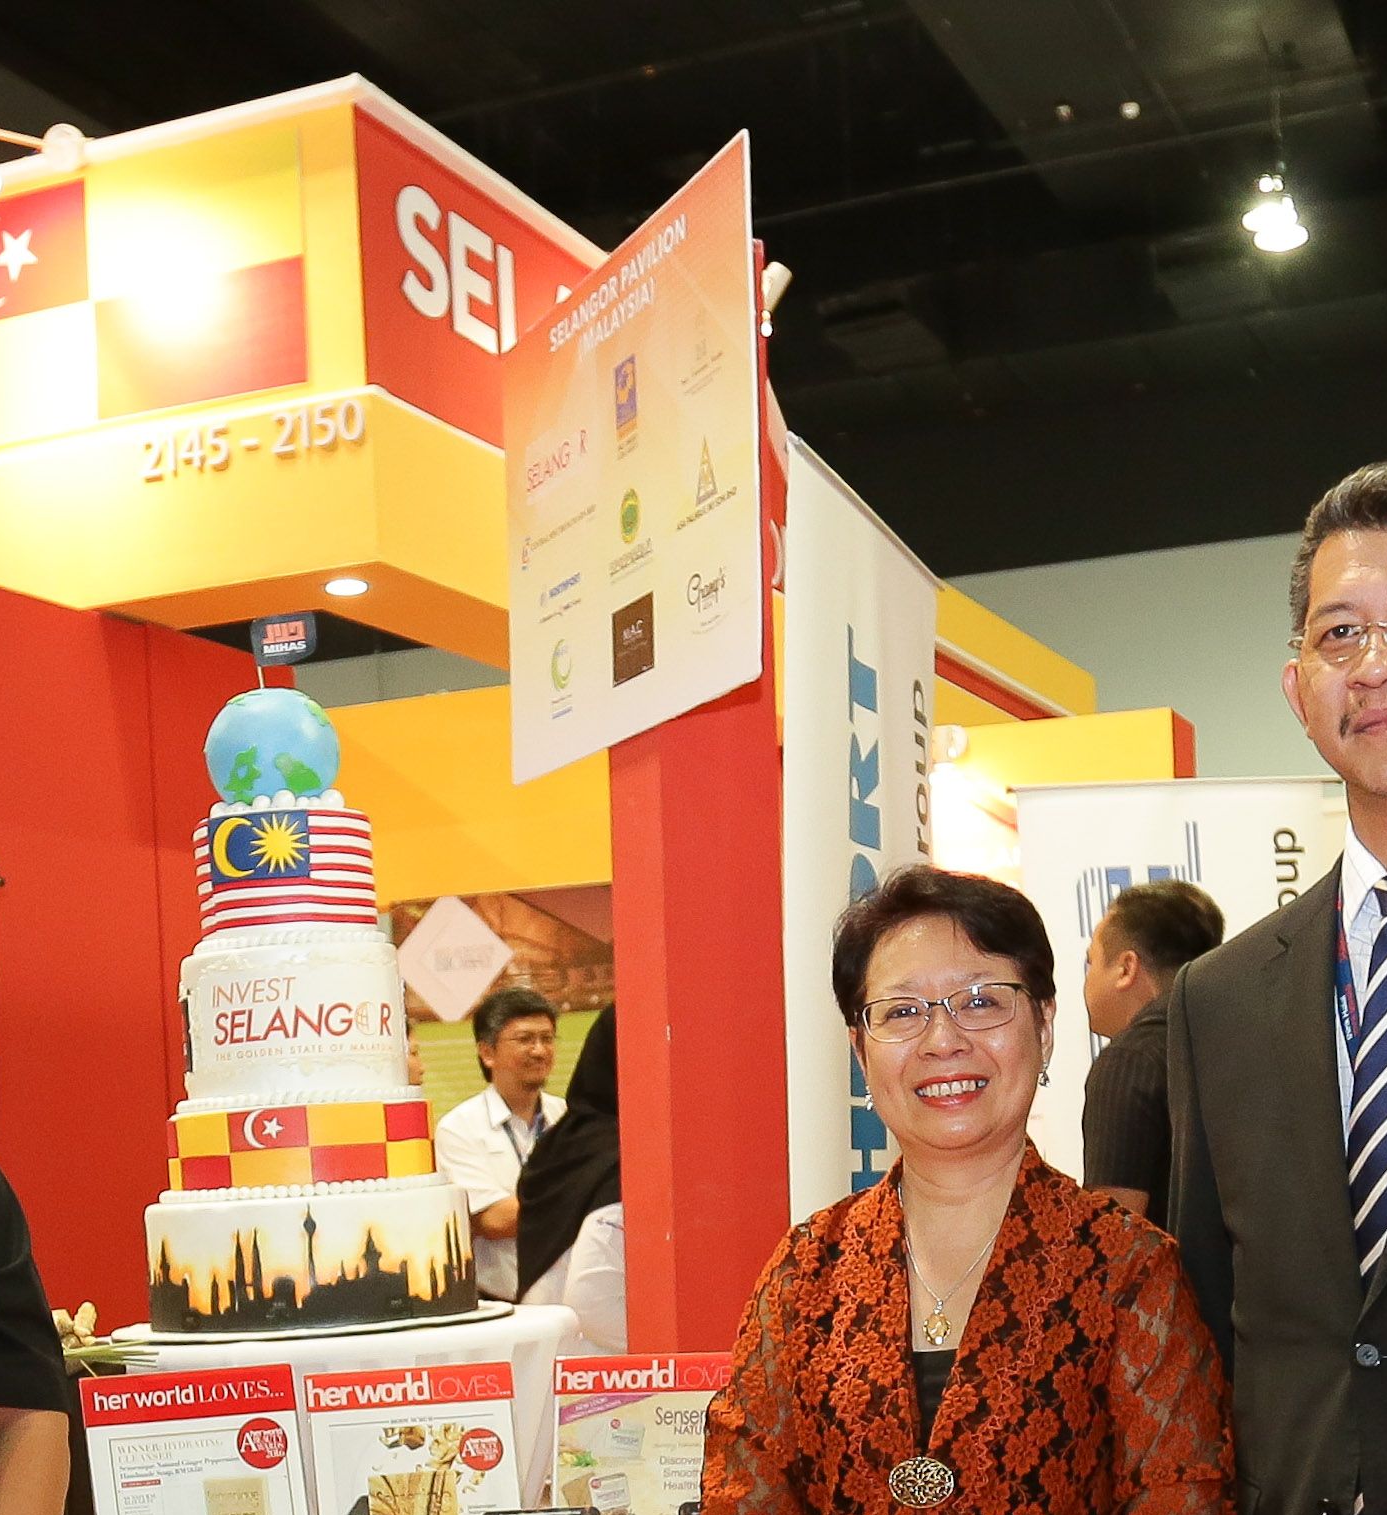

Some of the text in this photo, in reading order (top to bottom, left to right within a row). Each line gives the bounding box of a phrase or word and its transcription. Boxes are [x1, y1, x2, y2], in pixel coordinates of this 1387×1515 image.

[548, 213, 687, 352] SELANGOR PAVILION
[141, 424, 232, 482] 2145
[270, 401, 366, 460] 2150
[263, 640, 307, 654] MIHAS
[911, 677, 931, 856] roup
[1272, 827, 1306, 908] oup
[213, 976, 296, 1009] INVEST
[215, 1052, 231, 1062] THE
[236, 1046, 283, 1060] GOLDEN
[289, 1044, 323, 1055] STATE
[330, 1042, 344, 1053] OF
[305, 1378, 355, 1408] her
[354, 1370, 431, 1405] world
[555, 1359, 732, 1392] her world LOVE
[93, 1379, 286, 1412] her world LOVES...
[673, 1425, 703, 1436] NATU
